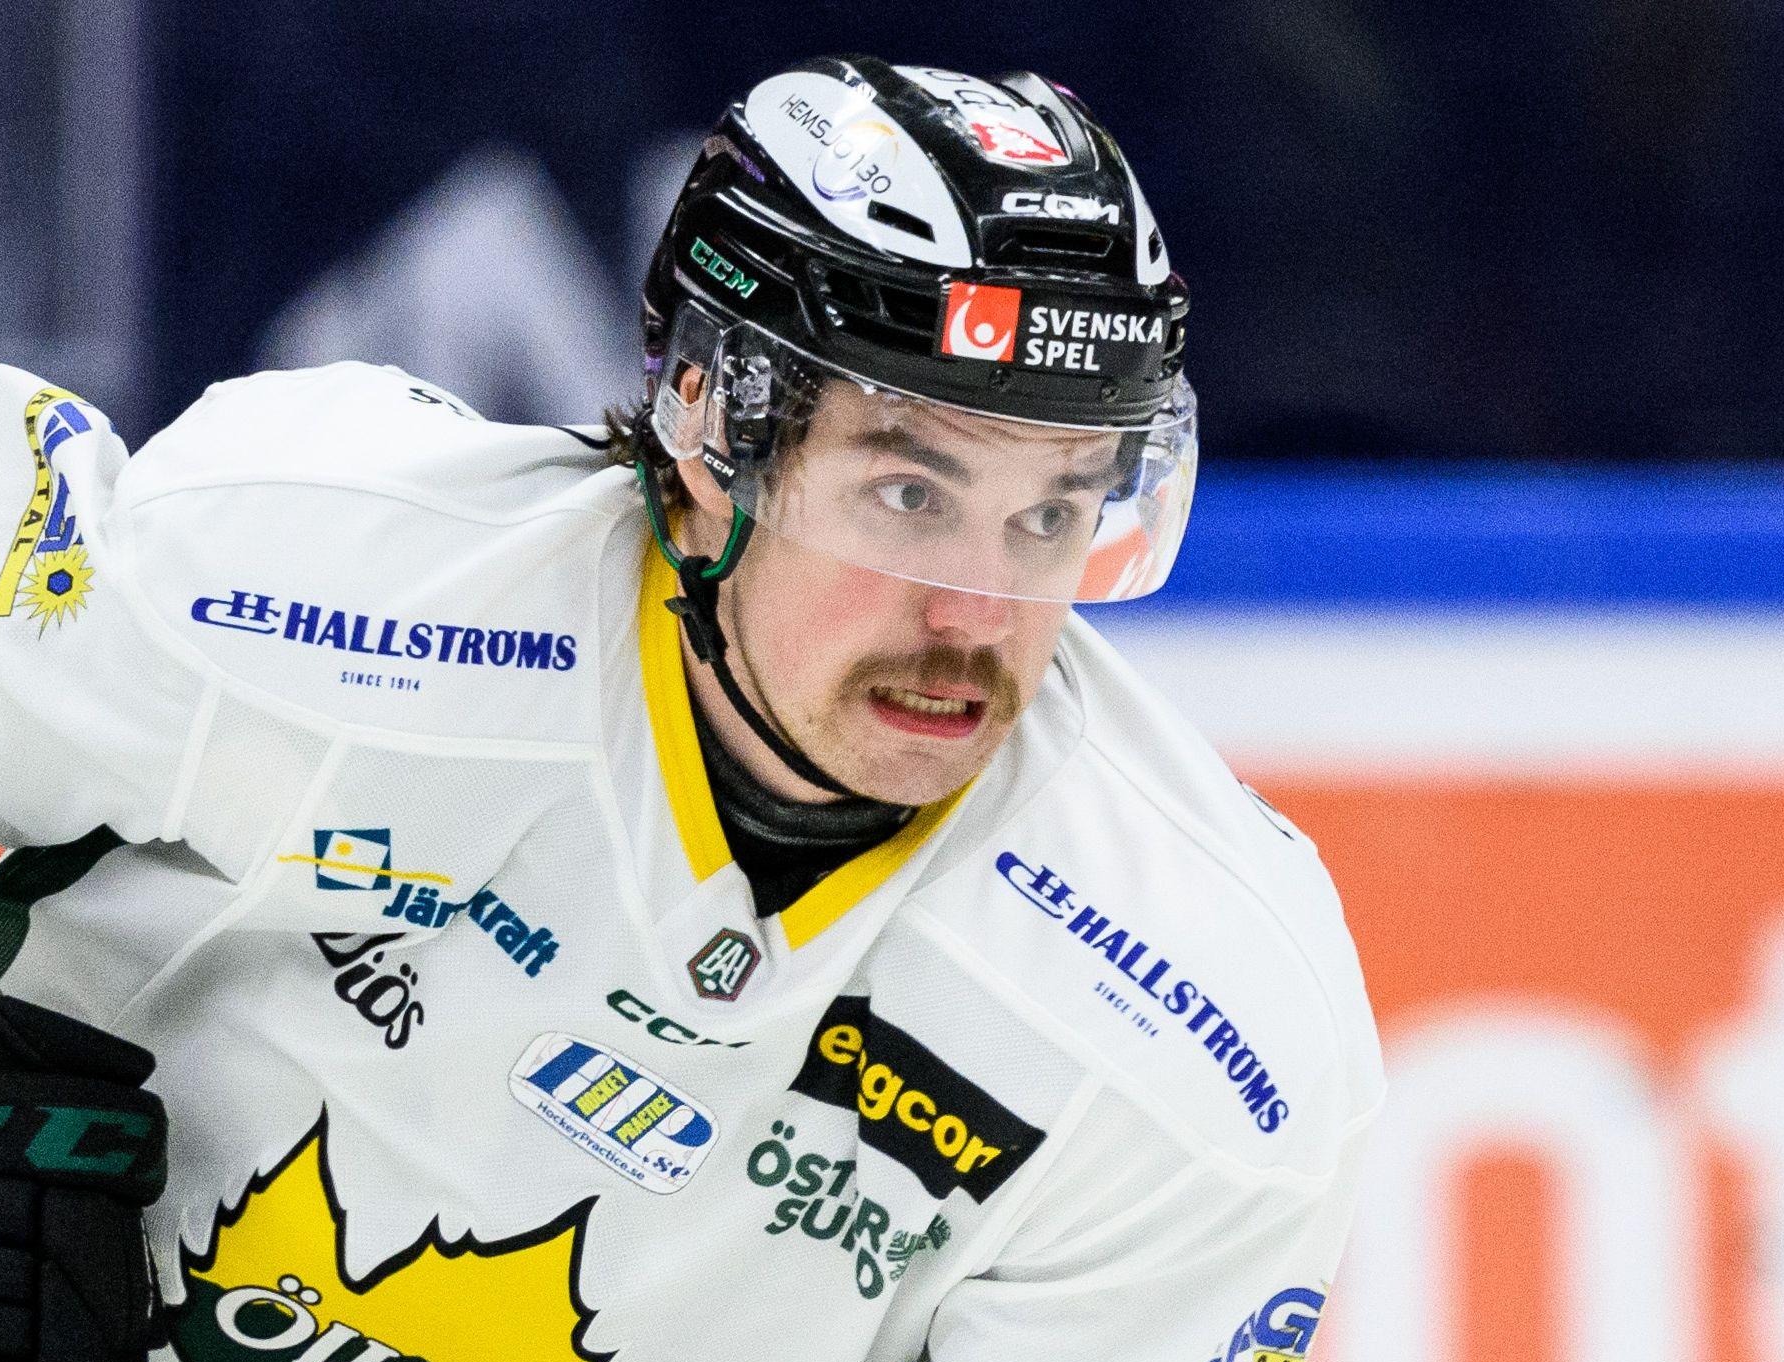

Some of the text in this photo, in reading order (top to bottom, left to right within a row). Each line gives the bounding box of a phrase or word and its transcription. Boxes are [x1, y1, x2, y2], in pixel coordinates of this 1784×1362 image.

[690, 236, 759, 299] CCM
[1024, 338, 1101, 371] SPEL
[1028, 306, 1163, 344] SVENSKA
[14, 393, 54, 552] RENTAL
[703, 453, 735, 477] CCM
[283, 601, 577, 672] HALLSTRÖMS
[340, 671, 421, 692] SINCE 1914
[606, 989, 755, 1048] CC
[1067, 905, 1290, 1134] HALLSTRÖMS
[1094, 981, 1131, 1014] SINCE
[537, 1101, 646, 1181] HockeyPractice.se
